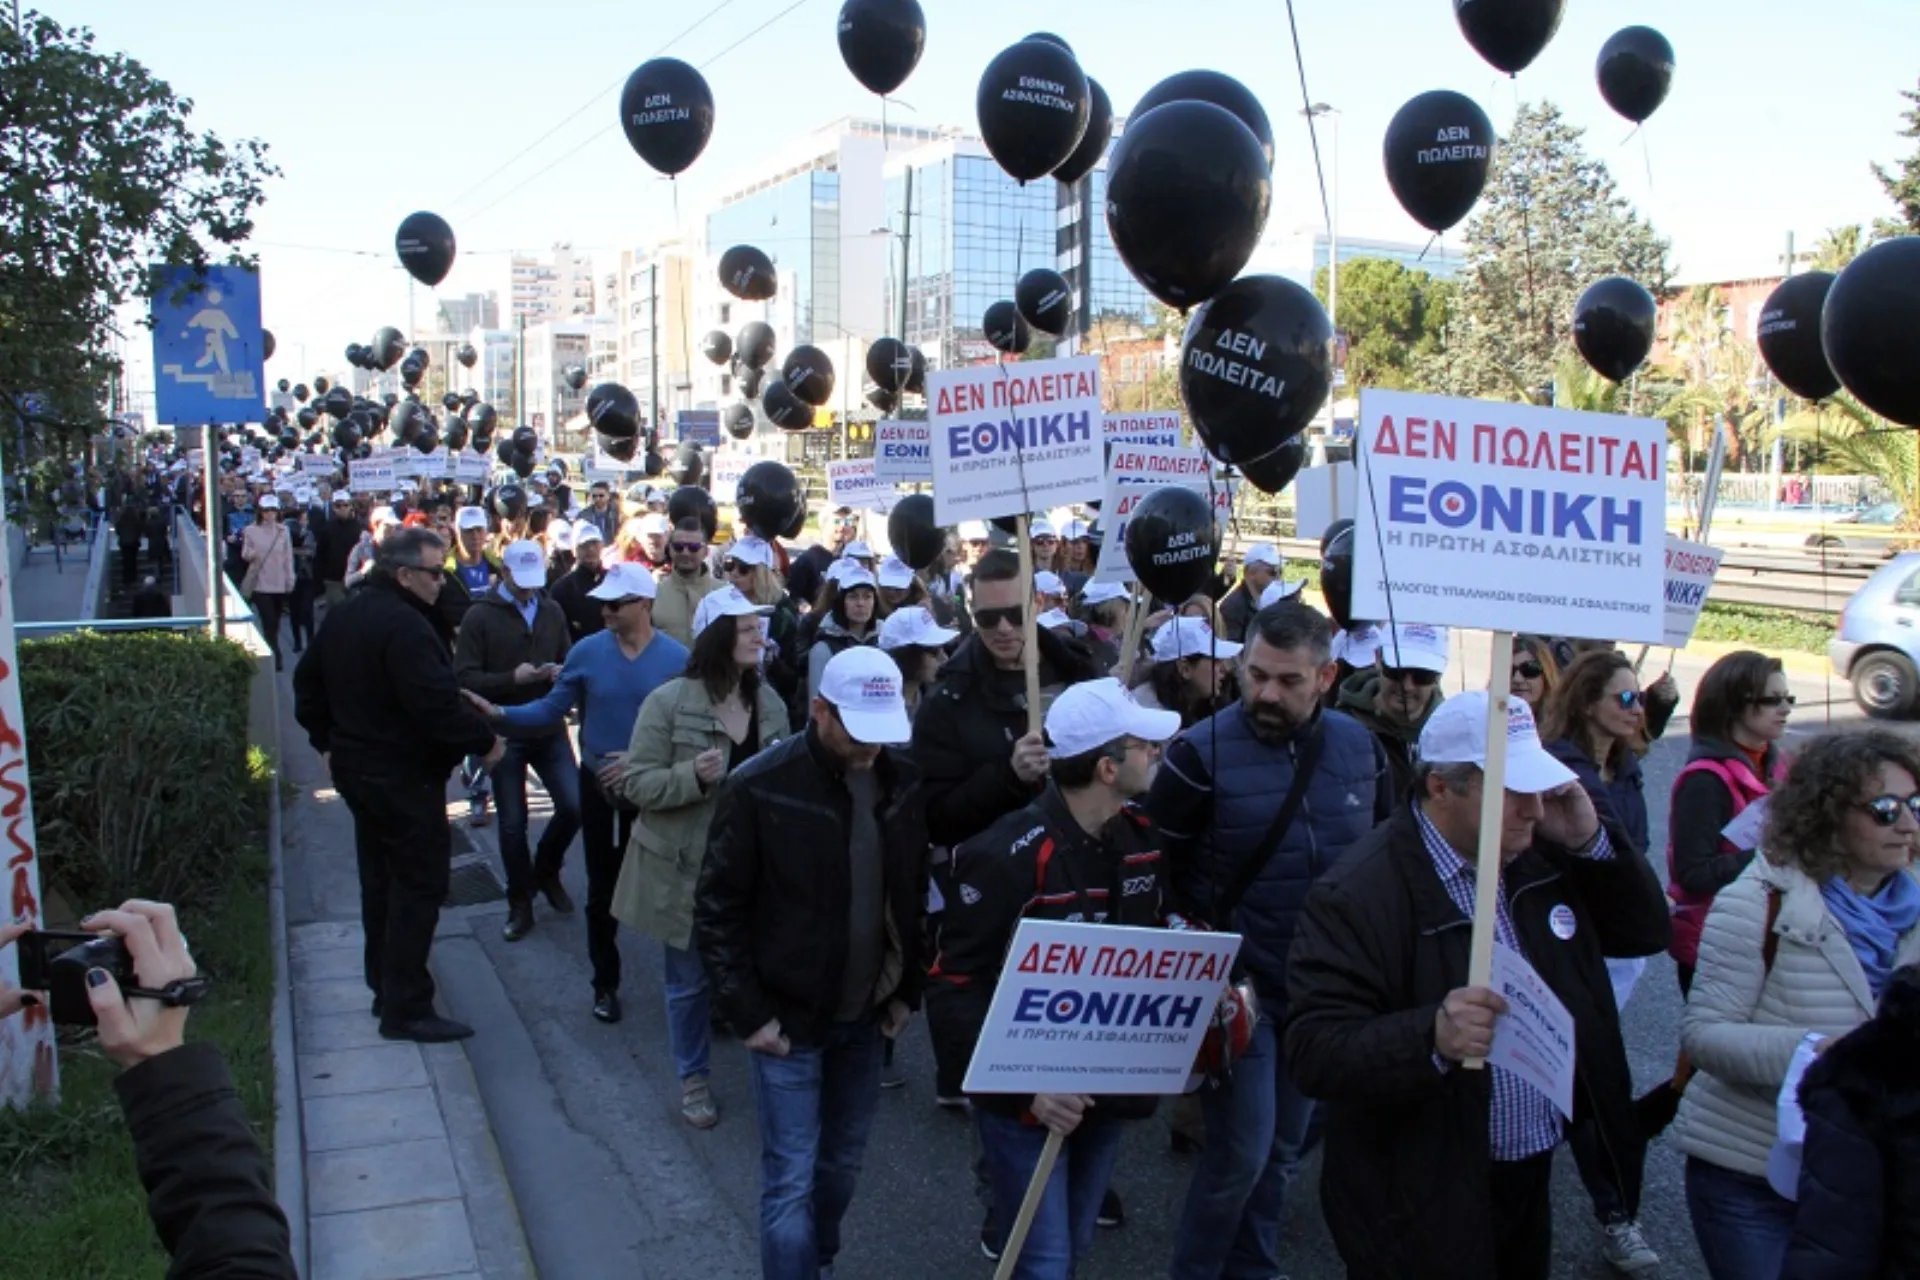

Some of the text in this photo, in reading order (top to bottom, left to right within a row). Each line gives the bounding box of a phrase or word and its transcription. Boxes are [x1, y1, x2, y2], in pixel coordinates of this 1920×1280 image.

[644, 93, 671, 108] ΔΕΝ
[632, 108, 690, 126] ΠΩΛΕΙΤΑΙ
[1436, 126, 1470, 142] ΔΕΝ
[1417, 145, 1487, 164] ΠΩΛΕΙΤΑΙ
[1215, 327, 1268, 361] ΔΕΝ
[1188, 346, 1286, 399] ΠΩΛΕΙΤΑΙ
[936, 369, 1098, 415] ΔΕΝ ΠΩΛΕΙΤΑΙ
[881, 428, 905, 440] ΔΕΝ
[1120, 417, 1179, 432] ΠΩΛΕΙΤΑΙ
[947, 410, 1091, 460] ΕΘΝΙΚΗ
[884, 443, 930, 458] ΕΘΝΙ
[1372, 414, 1659, 481] ΔΕΝ ΠΩΛΕΙΤΑΙ
[962, 457, 1007, 473] ΠΡΩΤΗ
[1114, 453, 1146, 471] ΔΕΝ
[1388, 475, 1643, 545] ΕΘΝΙΚΗ
[1167, 532, 1196, 549] ΔΕΝ
[1387, 531, 1402, 546] Η
[1409, 531, 1486, 554] ΠΡΩΤΗ
[1492, 537, 1642, 568] ΑΣΦΑΛΙΣΤΙΚΗ
[1152, 544, 1212, 566] ΠΩΛΕΙΤΑΙ
[1377, 579, 1439, 597] ΣΥΛΛΟΓΟΣ
[1664, 579, 1705, 606] ΝΙΚΗ
[1017, 942, 1229, 982] ΔΕΝ ΠΩΛΕΙΤΑΙ
[1012, 987, 1203, 1028] ΕΘΝΙΚΗ
[1006, 1028, 1190, 1044] Η ΠΡΩΤΗ ΑΣΦΑΛΙΣΤΙΚΗ
